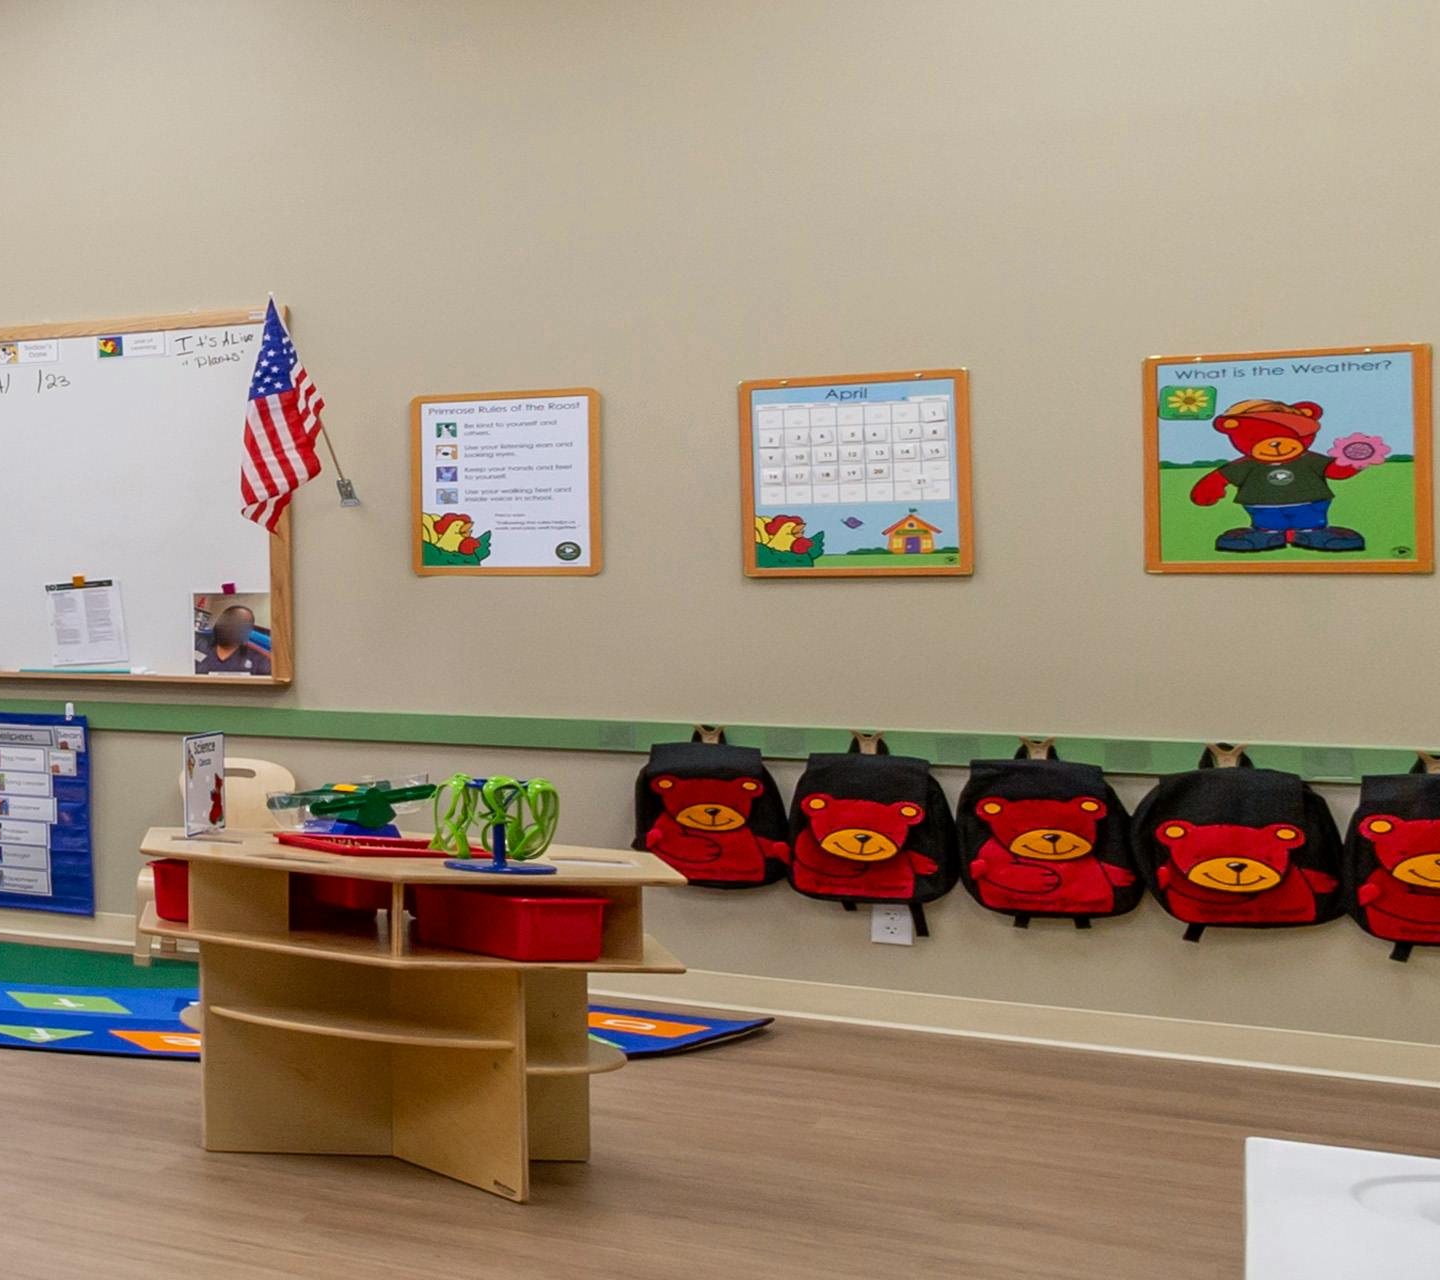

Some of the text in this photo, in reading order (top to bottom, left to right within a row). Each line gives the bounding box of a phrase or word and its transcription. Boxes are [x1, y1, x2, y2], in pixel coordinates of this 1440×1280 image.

[1174, 359, 1393, 381] What is the Weather?
[824, 387, 869, 401] April
[428, 401, 581, 416] Primrose Rules of the Roost
[476, 421, 495, 429] kind
[495, 420, 504, 428] to
[505, 419, 539, 429] yourself
[539, 418, 558, 427] and
[480, 444, 498, 452] your
[500, 441, 535, 451] listening
[555, 440, 574, 449] and
[463, 451, 495, 460] looking
[463, 466, 487, 475] Keep
[488, 465, 506, 474] your
[507, 464, 535, 473] hands
[535, 463, 554, 472] and
[480, 487, 499, 496] your
[500, 486, 534, 496] walking
[553, 485, 573, 494] and
[193, 741, 216, 755] Science
